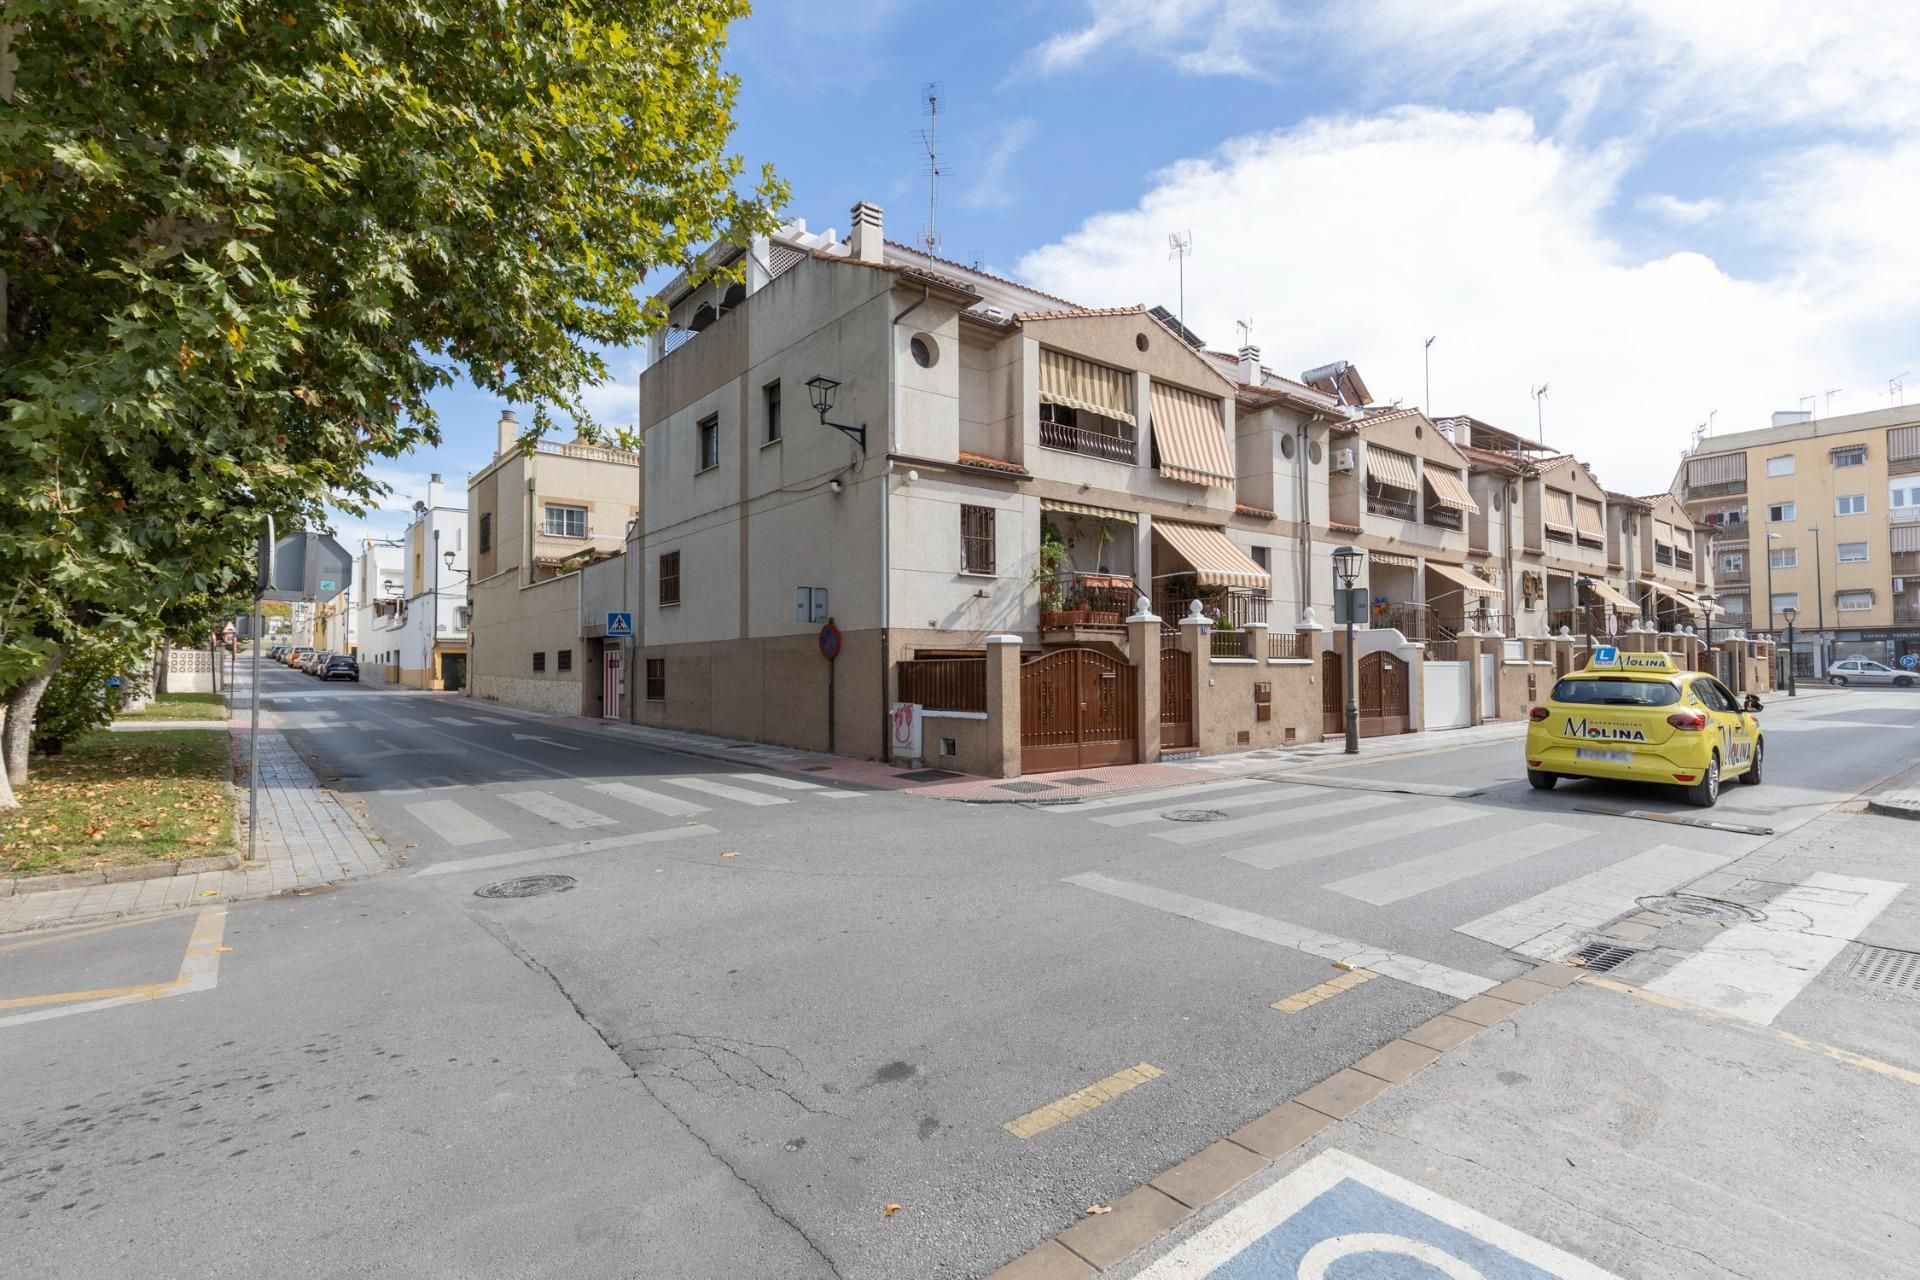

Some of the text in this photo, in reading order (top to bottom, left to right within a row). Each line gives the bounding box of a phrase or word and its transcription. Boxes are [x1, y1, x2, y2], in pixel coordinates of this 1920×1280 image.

[1599, 650, 1609, 659] L
[1614, 655, 1666, 667] MOLINA
[1563, 717, 1645, 741] MOLINA
